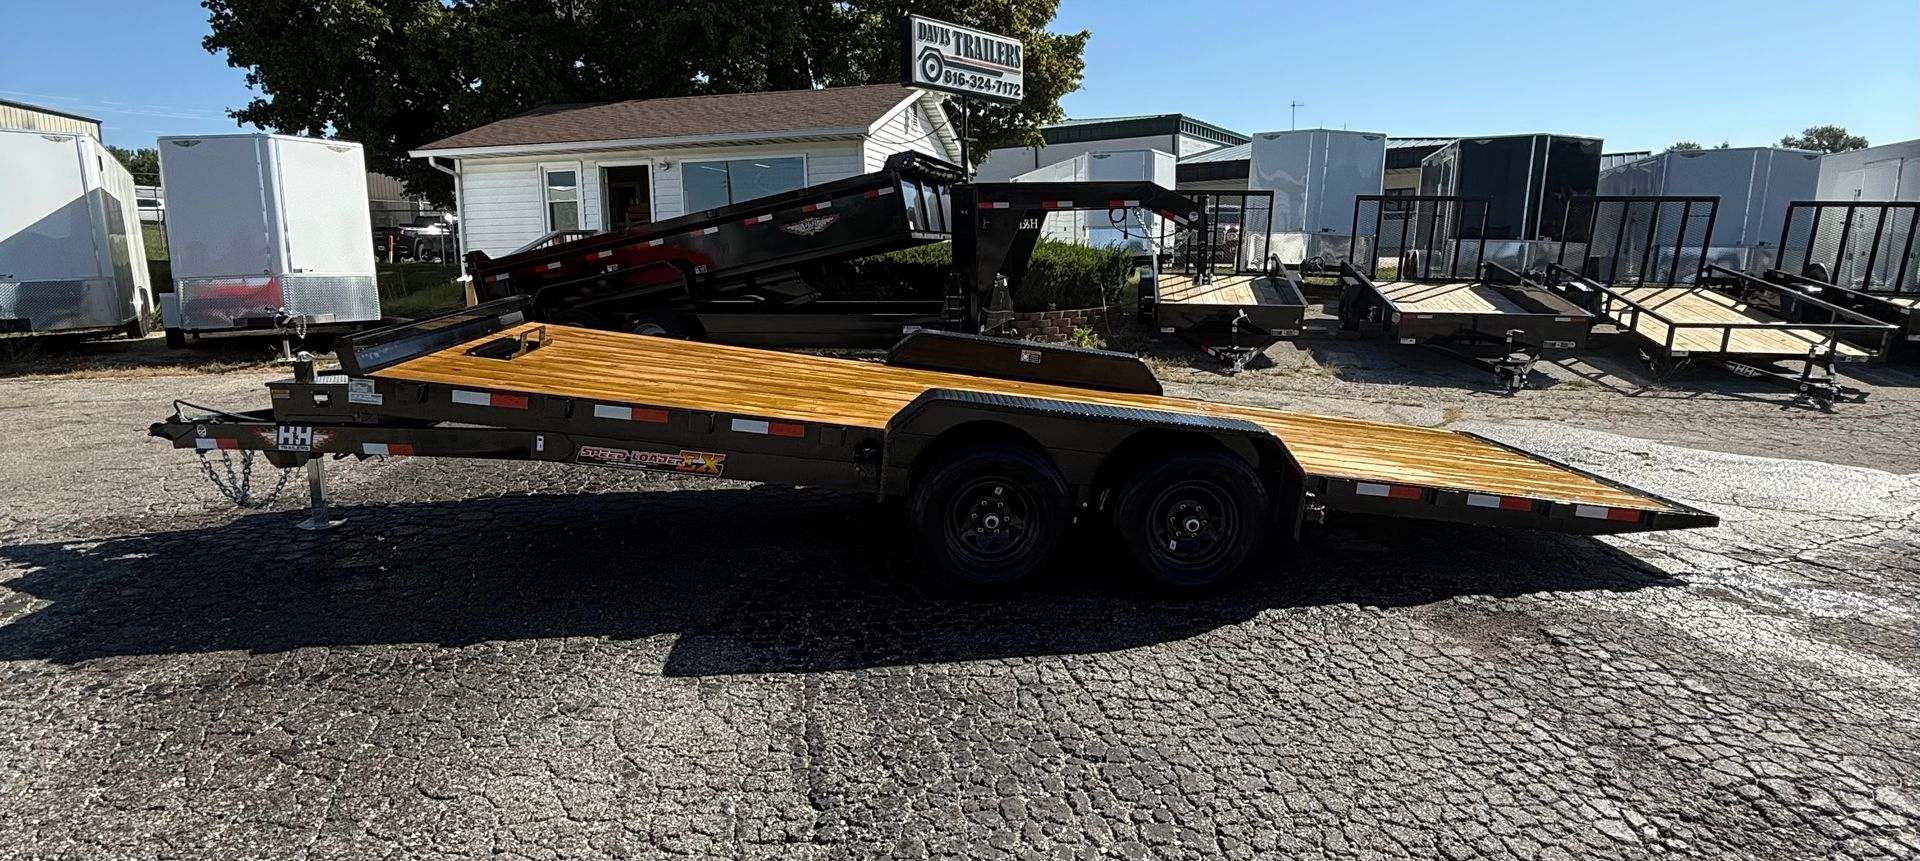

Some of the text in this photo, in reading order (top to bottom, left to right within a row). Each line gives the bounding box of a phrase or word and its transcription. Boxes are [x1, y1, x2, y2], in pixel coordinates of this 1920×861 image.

[918, 22, 1021, 69] DAVIS TRAILERS
[944, 70, 1021, 97] 816-324-7172
[580, 447, 627, 460] SPEED
[676, 450, 726, 475] EX
